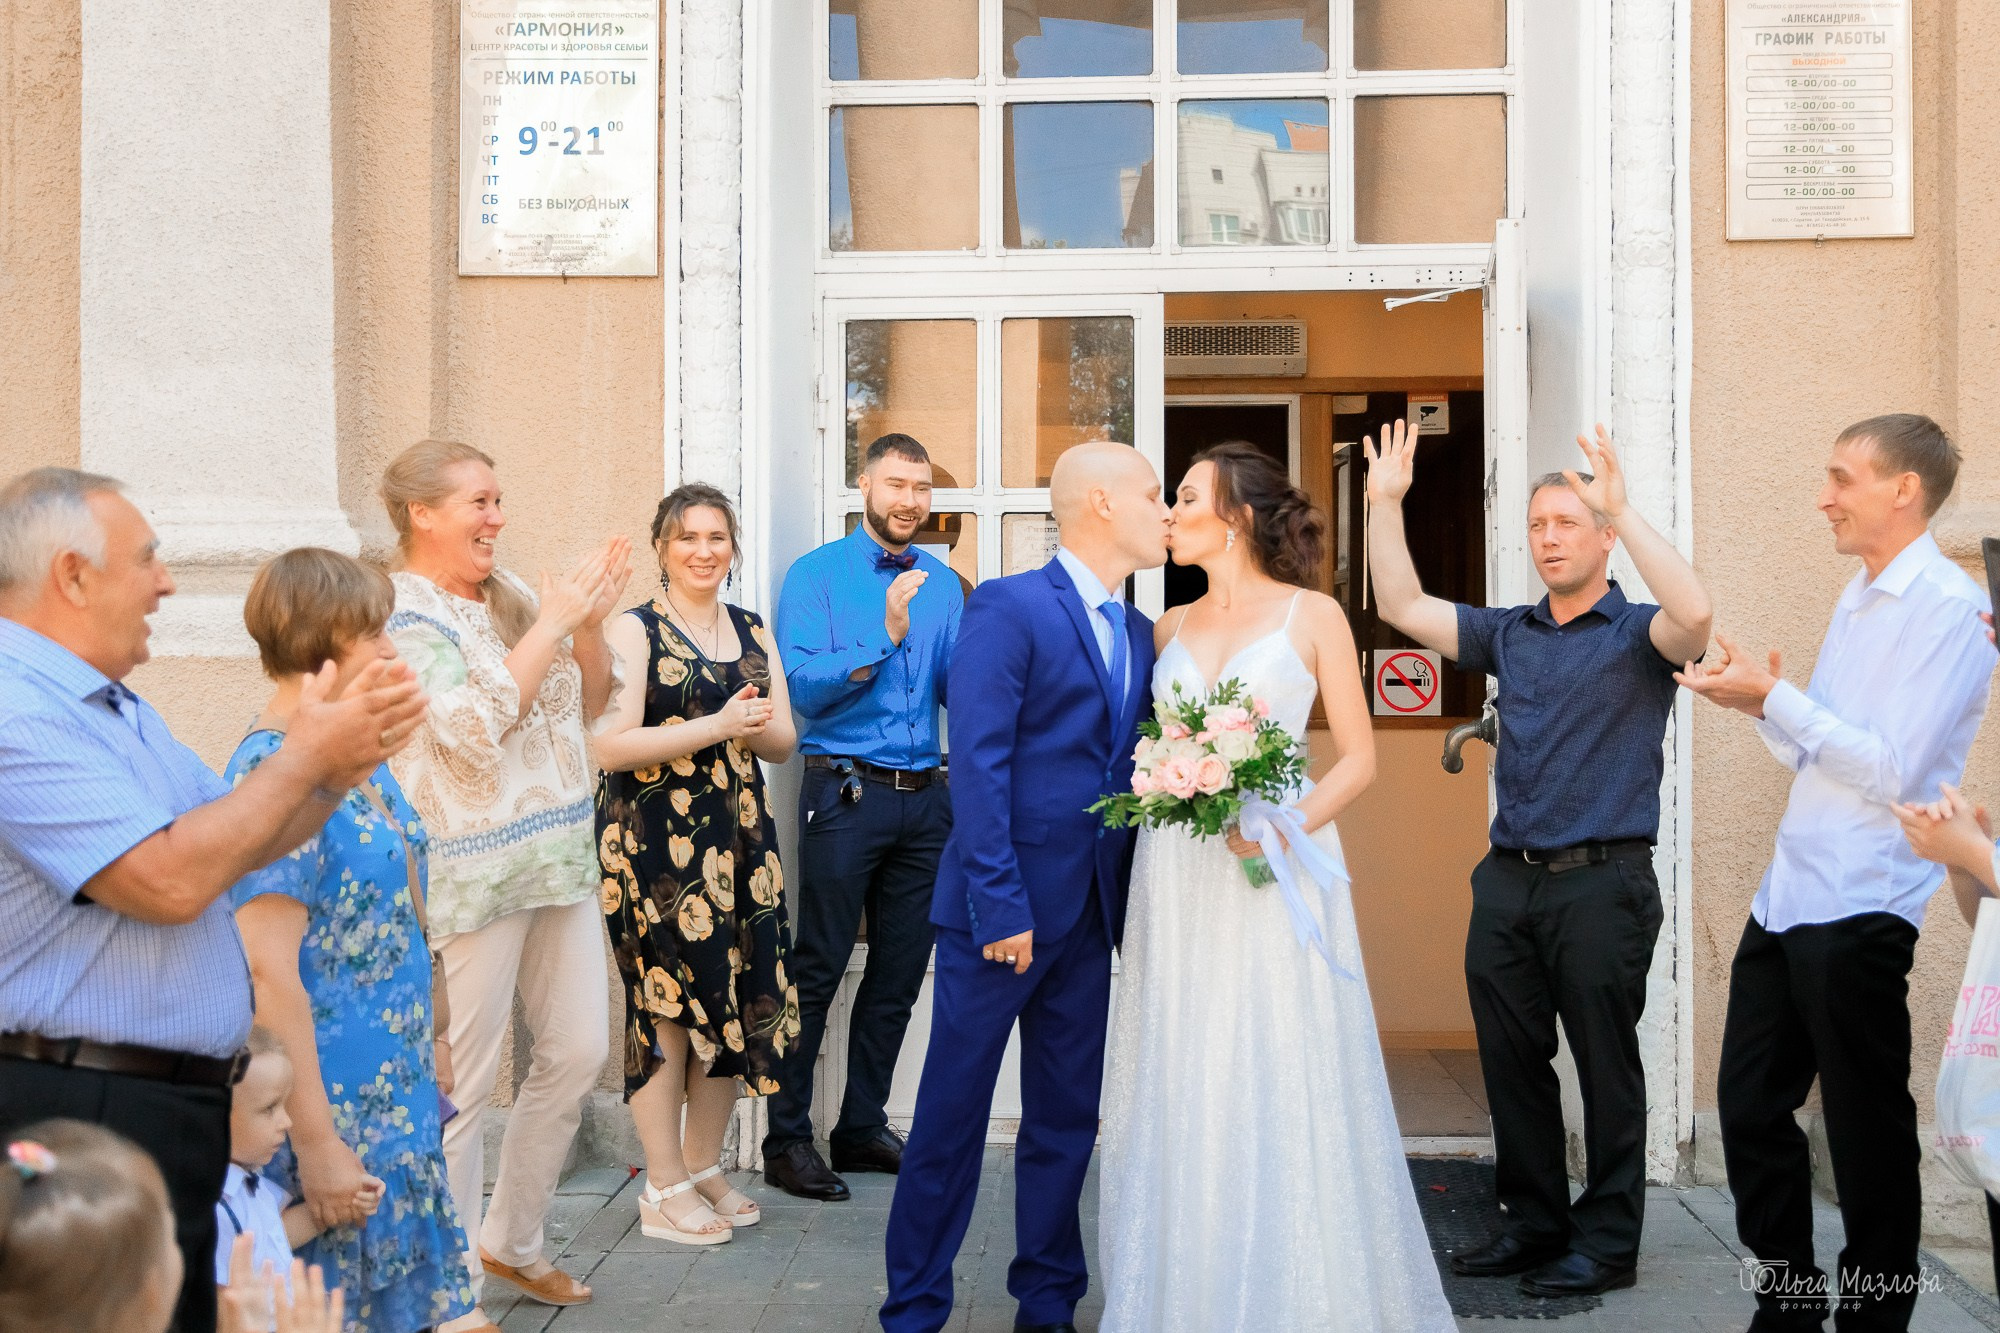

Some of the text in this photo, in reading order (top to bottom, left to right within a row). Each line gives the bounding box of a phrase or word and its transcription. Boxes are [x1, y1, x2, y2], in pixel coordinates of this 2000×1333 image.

[1781, 13, 1866, 24] «АЛЕКСАНДРИЯ»
[495, 22, 625, 37] «ГАРМОНИЯ»
[1755, 31, 1886, 46] ГРАФИК РАБОТЫ
[470, 43, 649, 52] ЦЕНТР КРАСОТЫ И ЗДОРОВЬЯ СЕМЬИ
[1791, 57, 1847, 67] ВЫХОДНОЙ
[483, 71, 636, 85] РЕЖИМ РАБОТЫ
[482, 95, 502, 106] ПН
[482, 115, 499, 126] ВТ
[482, 135, 499, 146] СР
[482, 155, 499, 166] ЧТ
[482, 175, 500, 186] ПТ
[482, 194, 499, 205] СБ
[518, 198, 630, 211] БЕЗ ВЫХОДНЫХ
[482, 213, 499, 224] ВС
